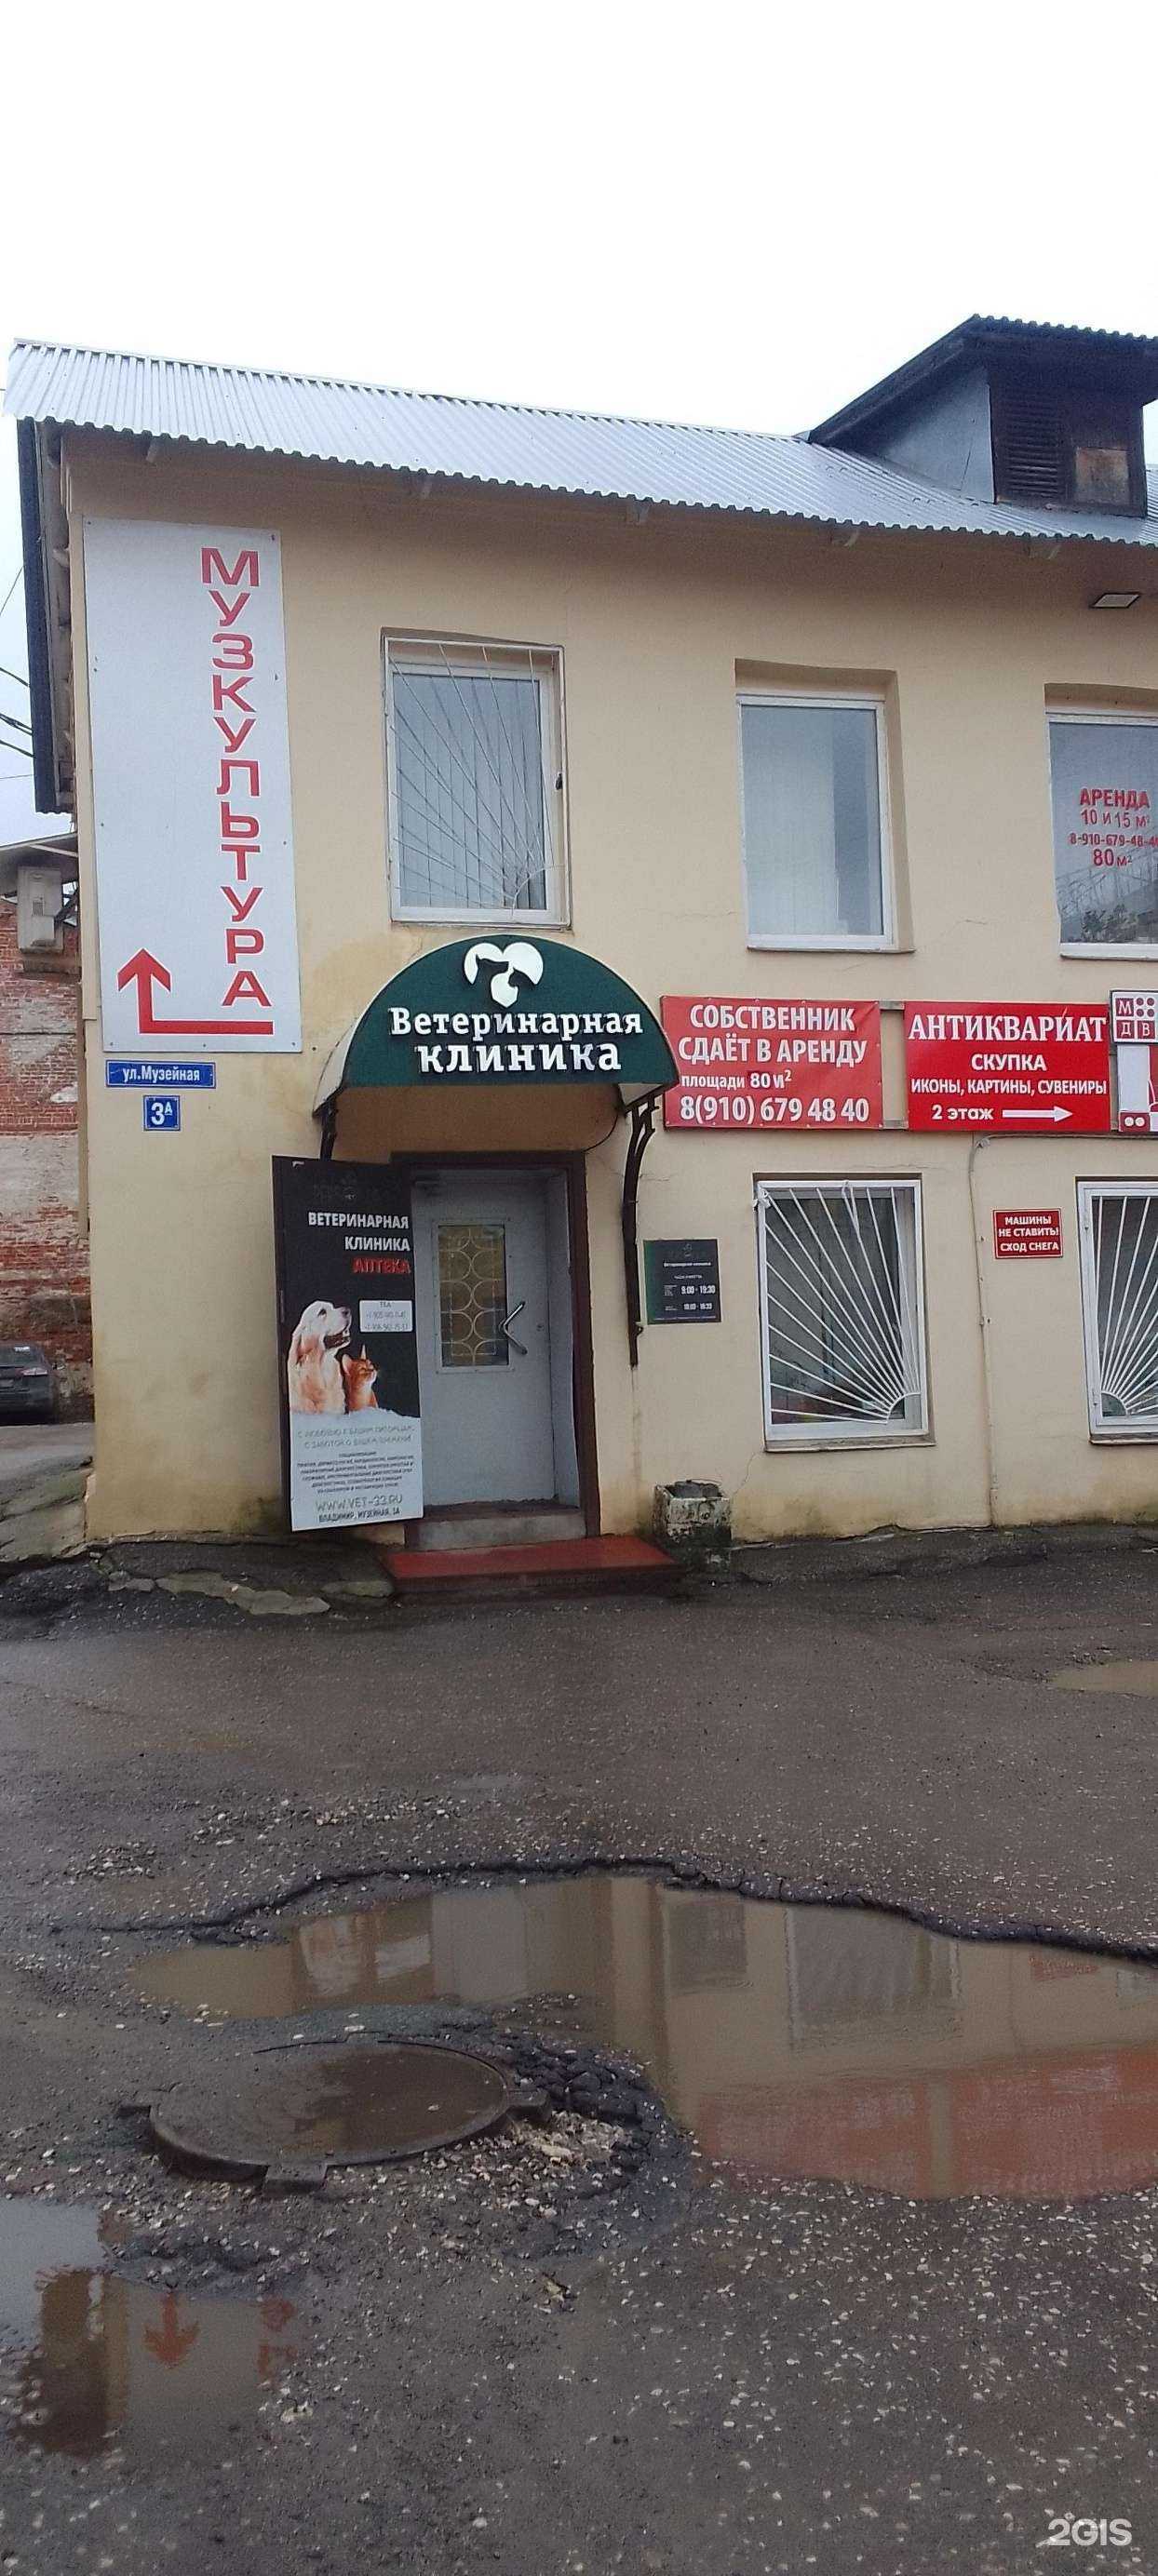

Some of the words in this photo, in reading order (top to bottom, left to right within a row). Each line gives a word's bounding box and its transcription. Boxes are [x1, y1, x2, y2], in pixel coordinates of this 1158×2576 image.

[200, 546, 272, 1007] МУЗКУЛЬТУРА
[1080, 788, 1150, 810] АРЕНДА
[1081, 809, 1097, 825] 10
[1115, 812, 1130, 828] 15
[1093, 849, 1114, 866] 80
[389, 1006, 643, 1041] Ветеринарная
[690, 1004, 855, 1031] СОБСТВЕННИК
[908, 1014, 1107, 1041] АНТИКВАРИАТ
[415, 1042, 622, 1073] клиника
[678, 1033, 751, 1065] СДАЁТ
[756, 1039, 772, 1063] В
[776, 1040, 868, 1067] АРЕНДУ
[971, 1053, 1046, 1071] СКУПКА
[122, 1066, 200, 1082] ул.Музейная
[680, 1074, 746, 1091] площади
[749, 1072, 771, 1089] 80
[911, 1078, 964, 1095] ИКОНЫ,
[967, 1079, 1035, 1096] КАРТИНЫ,
[1038, 1080, 1107, 1094] СУВЕНИРЫ
[151, 1101, 173, 1125] 3А
[680, 1095, 755, 1124] 8(910)
[760, 1097, 802, 1121] 679
[807, 1098, 836, 1121] 48
[841, 1098, 869, 1122] 40
[932, 1105, 942, 1120] 2
[947, 1107, 993, 1120] этаж
[308, 1212, 409, 1229] ВЕТЕРИНАРНАЯ
[1004, 1215, 1052, 1226] МАШИНЫ
[998, 1228, 1012, 1238] НЕ
[344, 1236, 411, 1252] КЛИНИКА
[1000, 1242, 1027, 1253] СХОД
[1029, 1241, 1059, 1252] СНЕГА
[353, 1257, 411, 1274] АПТЕКА
